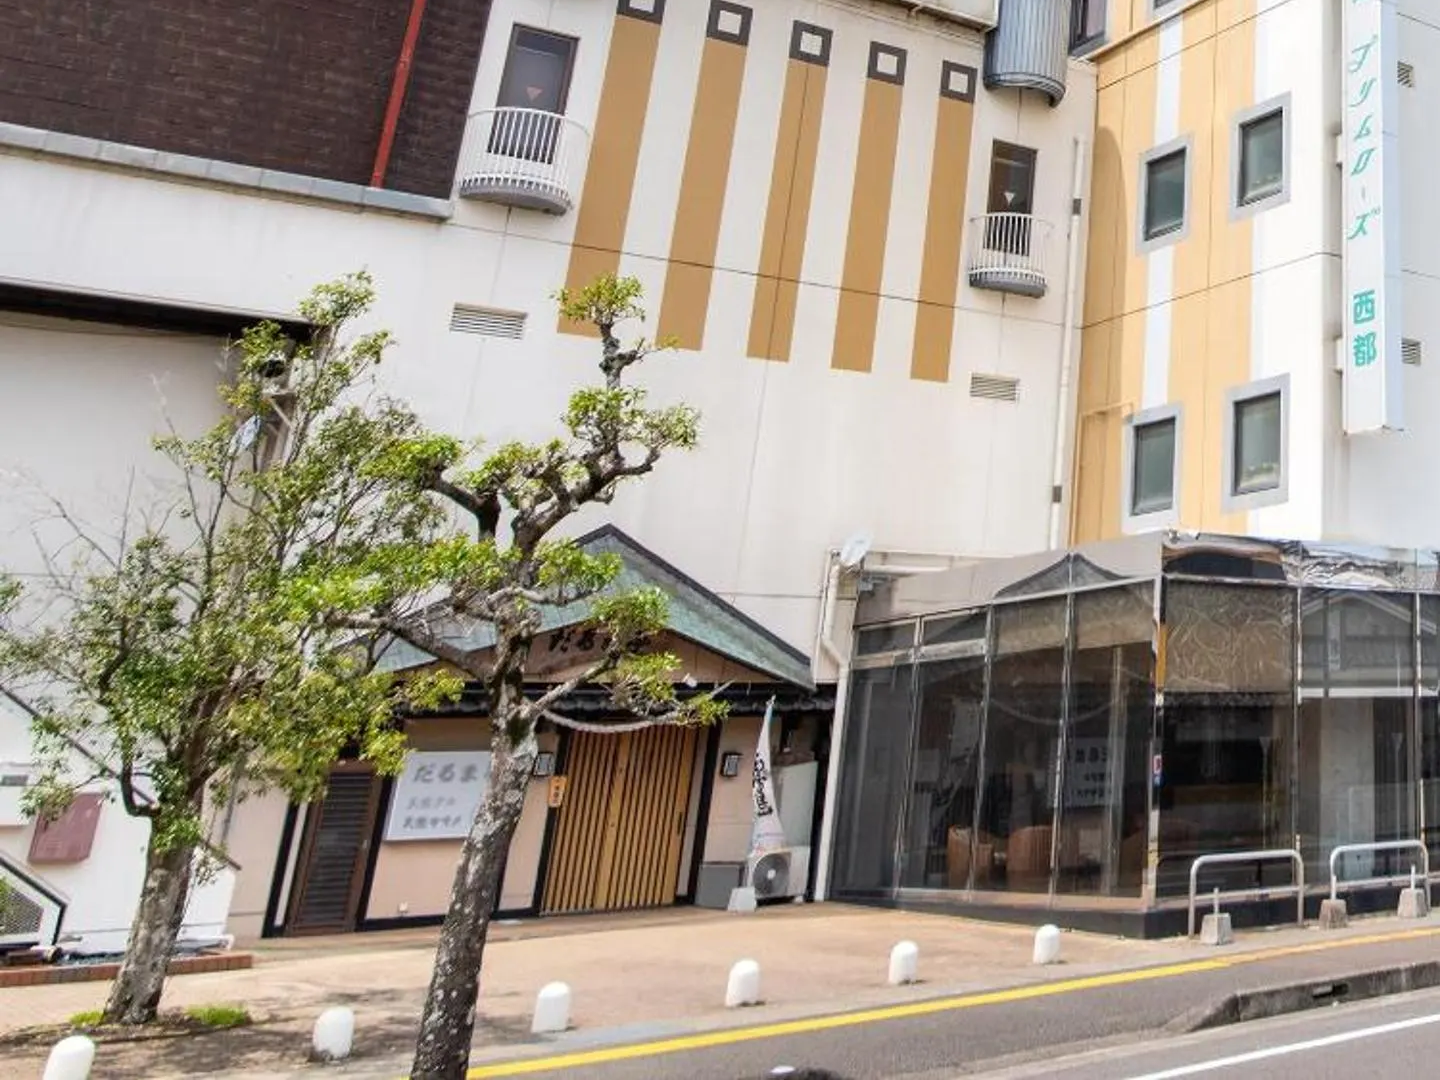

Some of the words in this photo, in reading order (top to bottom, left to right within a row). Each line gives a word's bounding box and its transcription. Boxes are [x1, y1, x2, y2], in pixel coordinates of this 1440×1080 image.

[1347, 33, 1381, 240] プリムローズ
[1352, 288, 1378, 367] 西都
[412, 762, 493, 784] だるま
